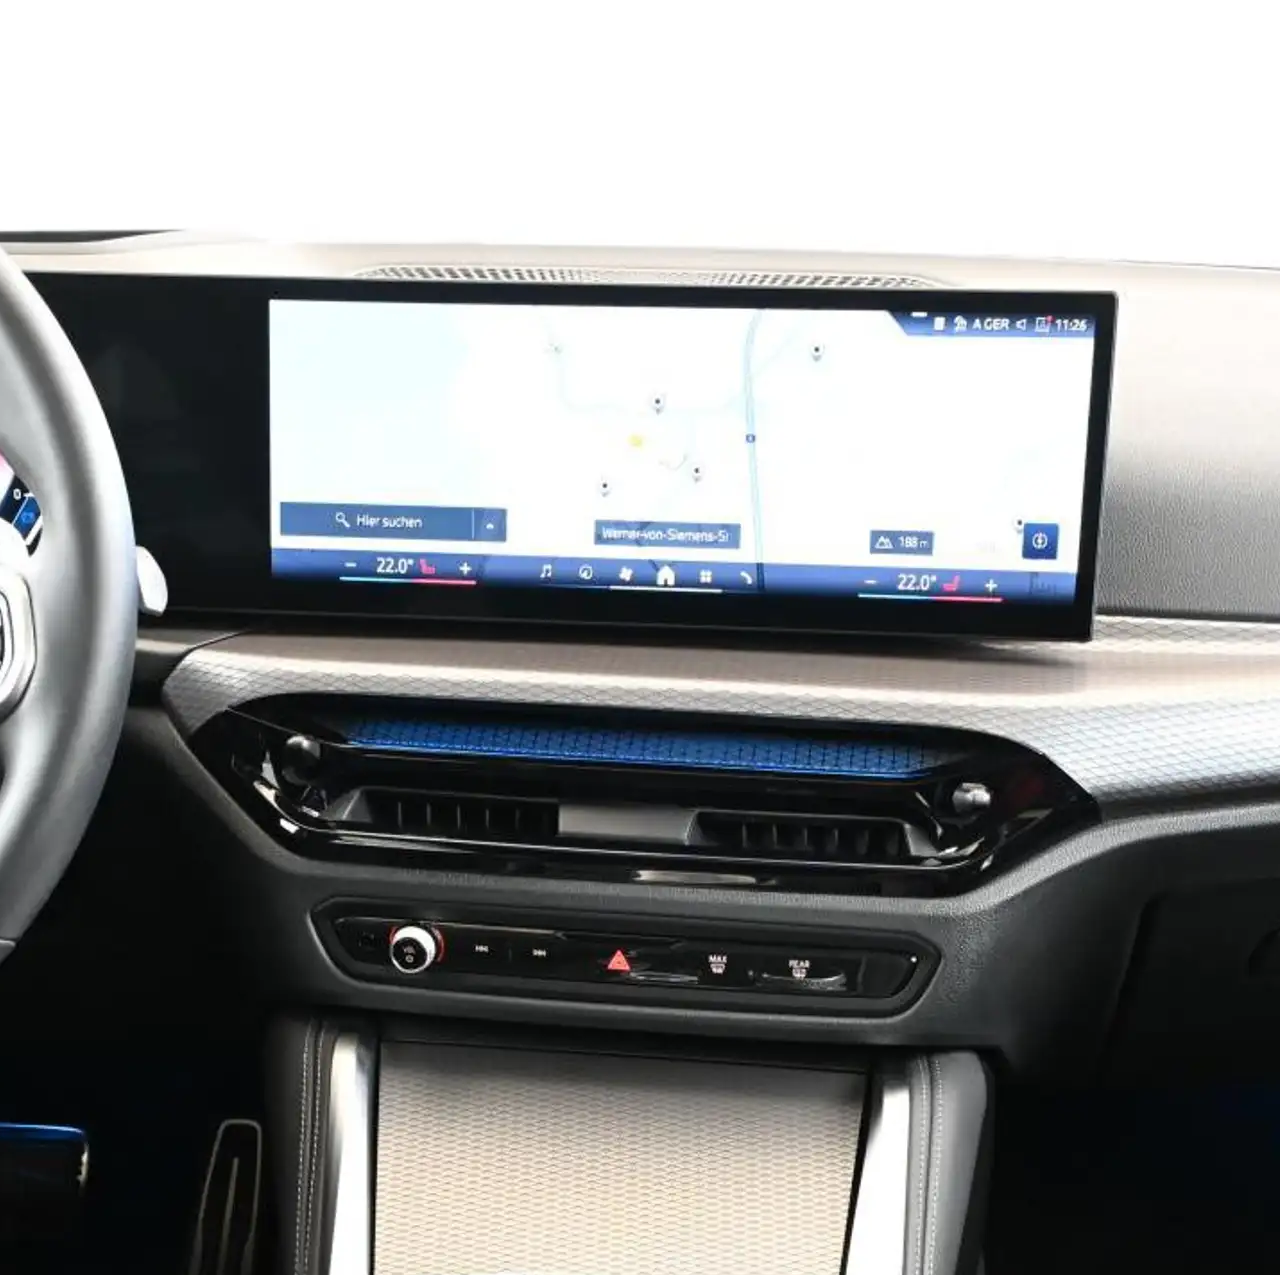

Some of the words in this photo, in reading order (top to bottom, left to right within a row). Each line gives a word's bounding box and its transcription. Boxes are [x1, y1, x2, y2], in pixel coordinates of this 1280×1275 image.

[984, 317, 1010, 331] GER
[1055, 318, 1088, 332] 11:26
[356, 514, 380, 528] Hier
[383, 515, 423, 529] suchen
